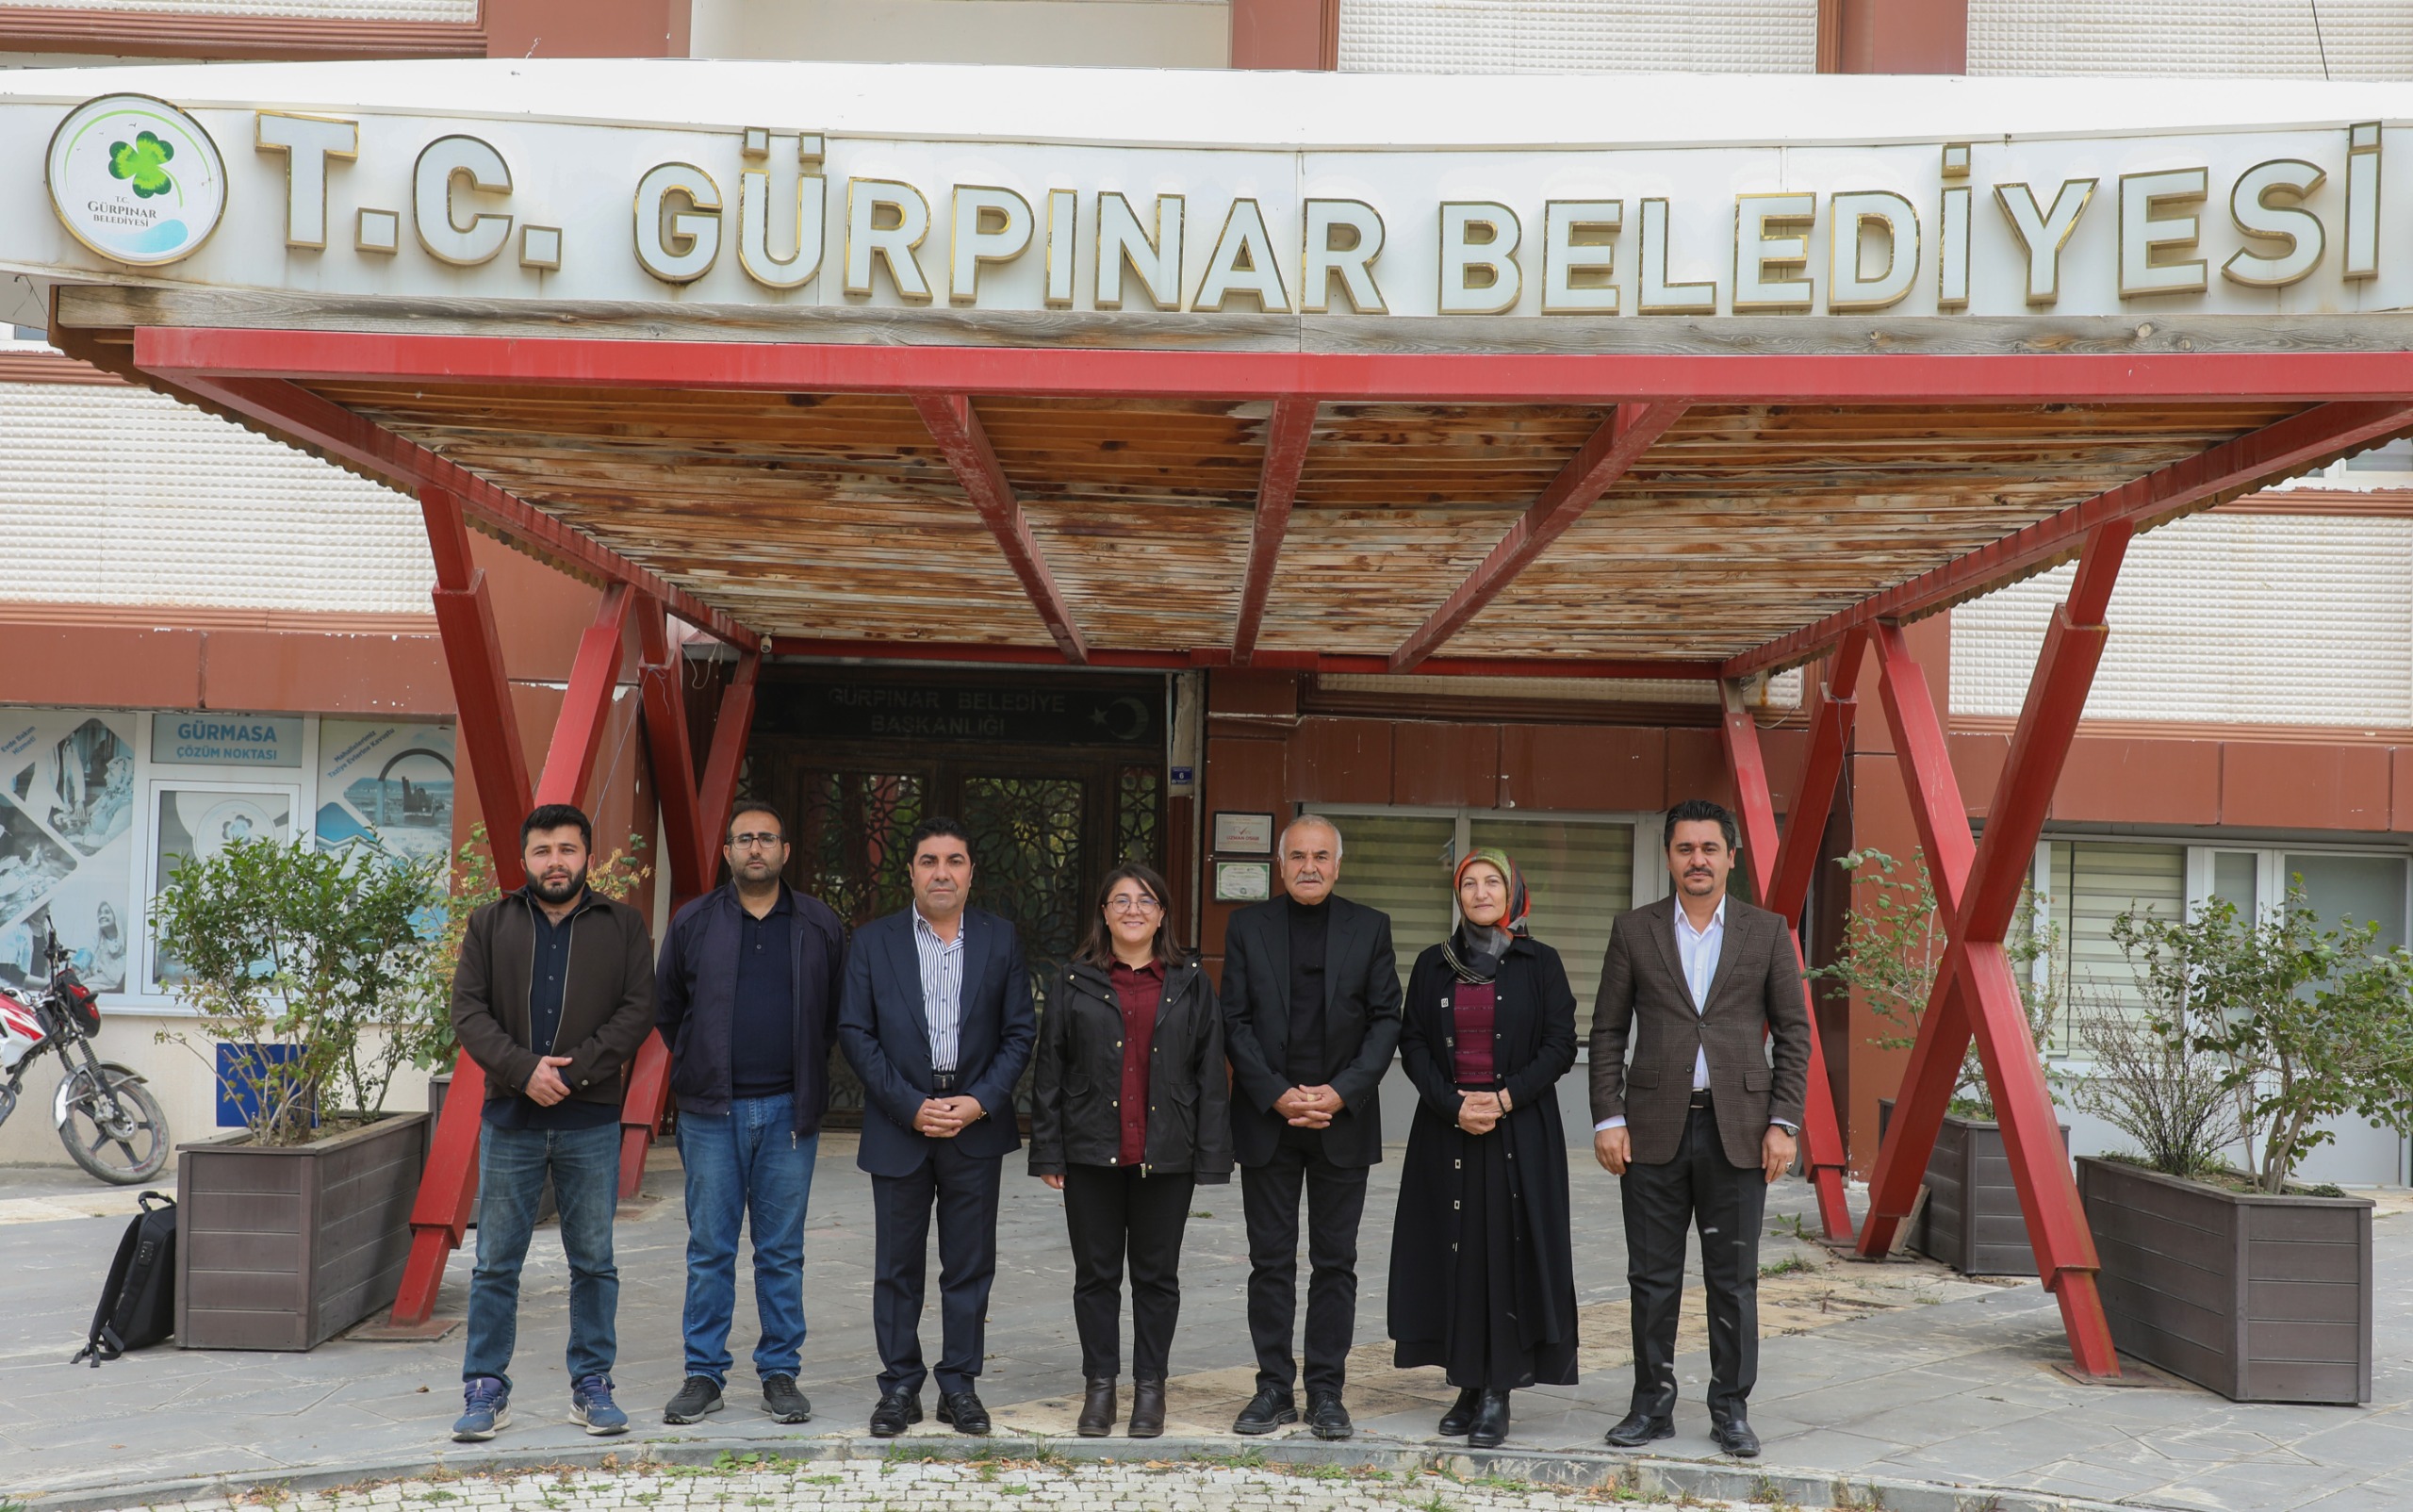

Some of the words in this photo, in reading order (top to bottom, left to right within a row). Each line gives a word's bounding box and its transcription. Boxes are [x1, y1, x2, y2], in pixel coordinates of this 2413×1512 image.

[88, 201, 156, 219] GÜRPINAR
[93, 214, 149, 227] BELEDİYESİ
[254, 109, 562, 271] T.C.
[632, 126, 1389, 315] GÜRPINAR
[1438, 121, 2383, 316] BELEDİYESİ
[828, 682, 941, 710] GÜRPINAR
[958, 690, 1066, 714] BELEDİYE
[177, 720, 277, 743] GÜRMASA
[871, 714, 1006, 738] BAŞKANLIĞI
[1, 739, 17, 753] Evde
[15, 726, 36, 742] Bakım
[12, 735, 36, 755] Hizmeti
[334, 730, 377, 763] Mahallelerimiz
[176, 745, 221, 759] ÇÖZÜM
[223, 748, 277, 761] NOKTASI
[327, 762, 348, 778] Taziye
[346, 745, 371, 764] Evlerine
[370, 728, 396, 748] Kavuştu
